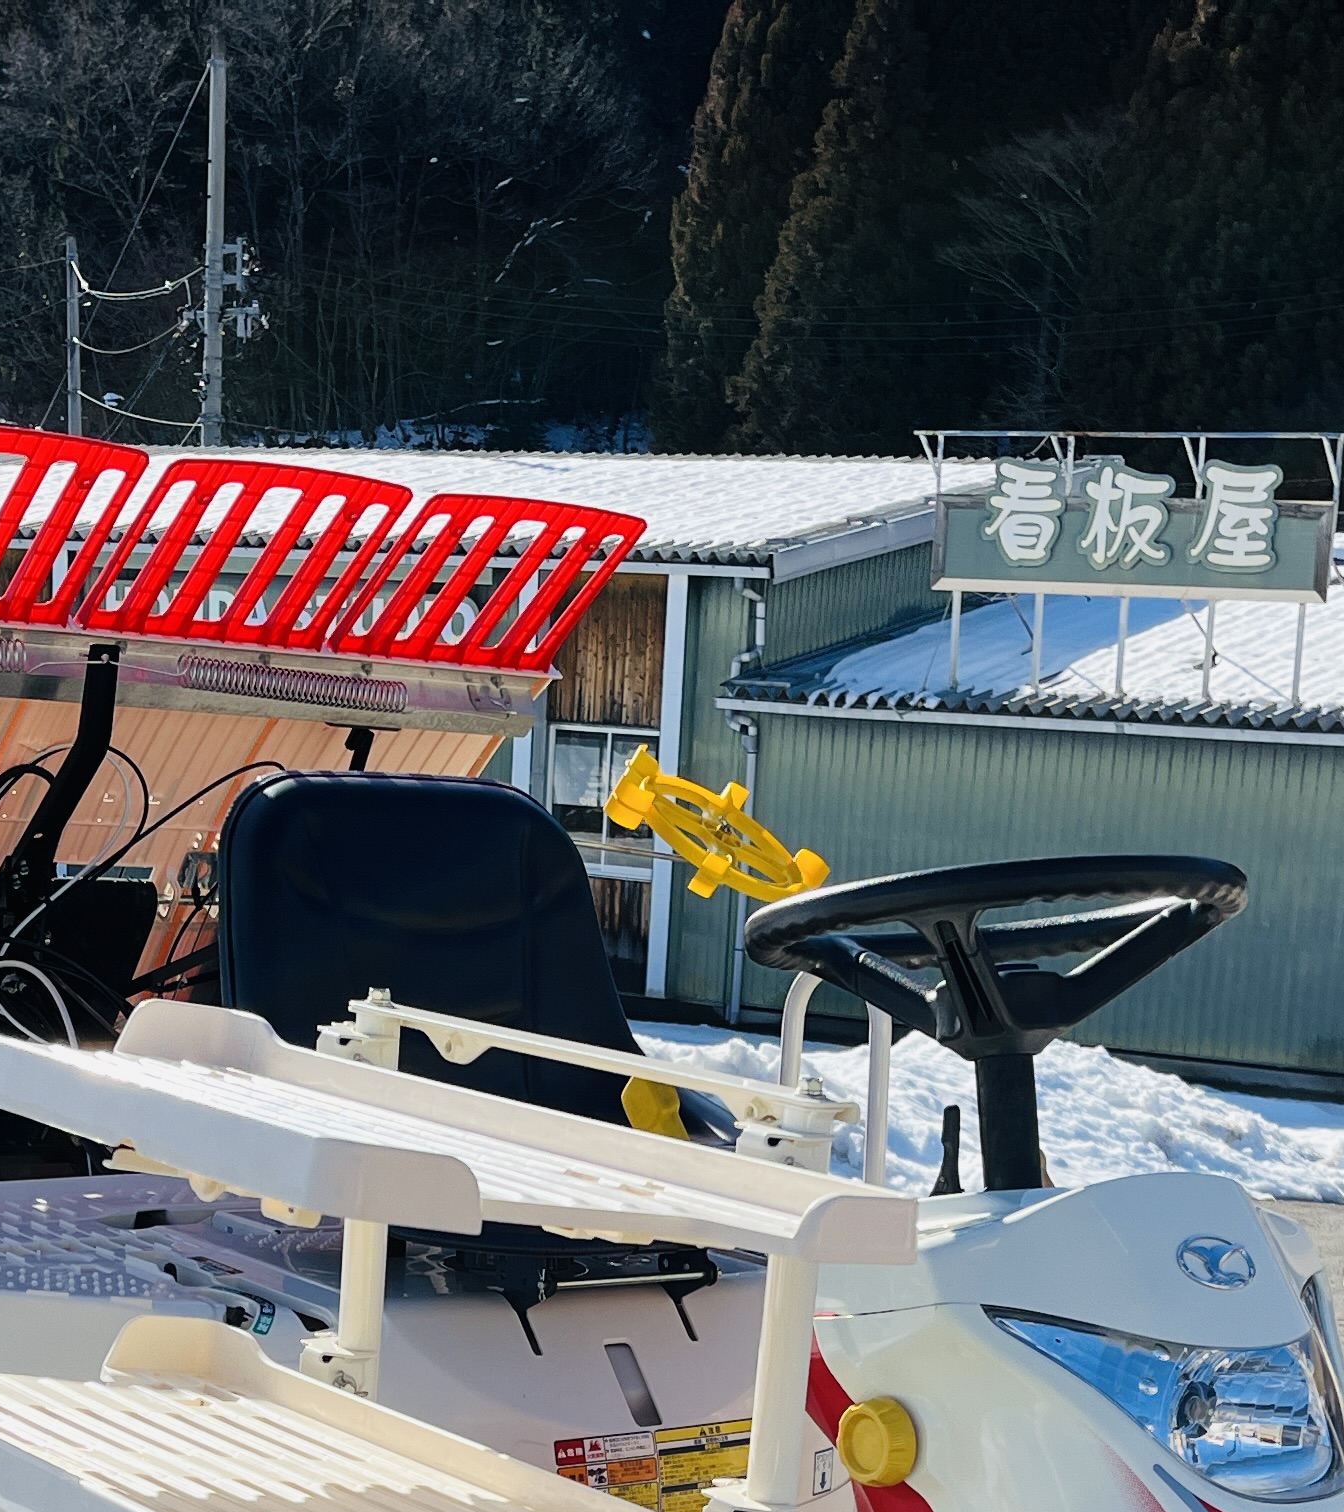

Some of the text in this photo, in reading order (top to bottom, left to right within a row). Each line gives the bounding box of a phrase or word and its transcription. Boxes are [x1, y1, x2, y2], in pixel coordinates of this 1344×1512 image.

[983, 459, 1278, 568] 看板屋
[290, 595, 477, 645] TUDO
